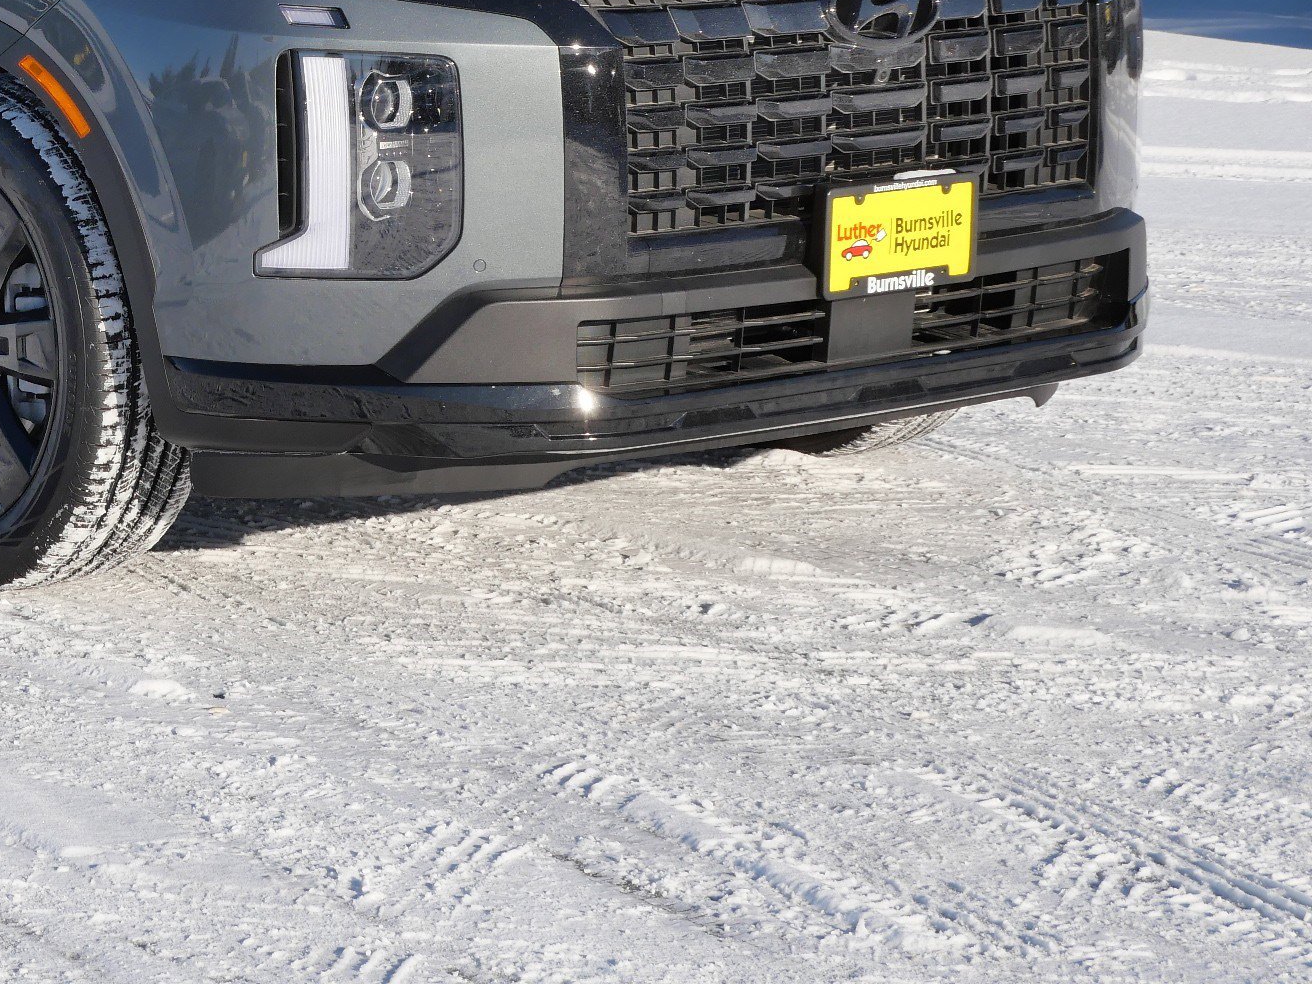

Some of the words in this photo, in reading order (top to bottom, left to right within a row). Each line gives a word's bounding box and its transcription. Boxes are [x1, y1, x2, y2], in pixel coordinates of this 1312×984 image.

[837, 222, 883, 242] Luther
[895, 209, 963, 235] Burnsville
[894, 229, 950, 256] Hyundai
[867, 269, 935, 294] Burnsville
